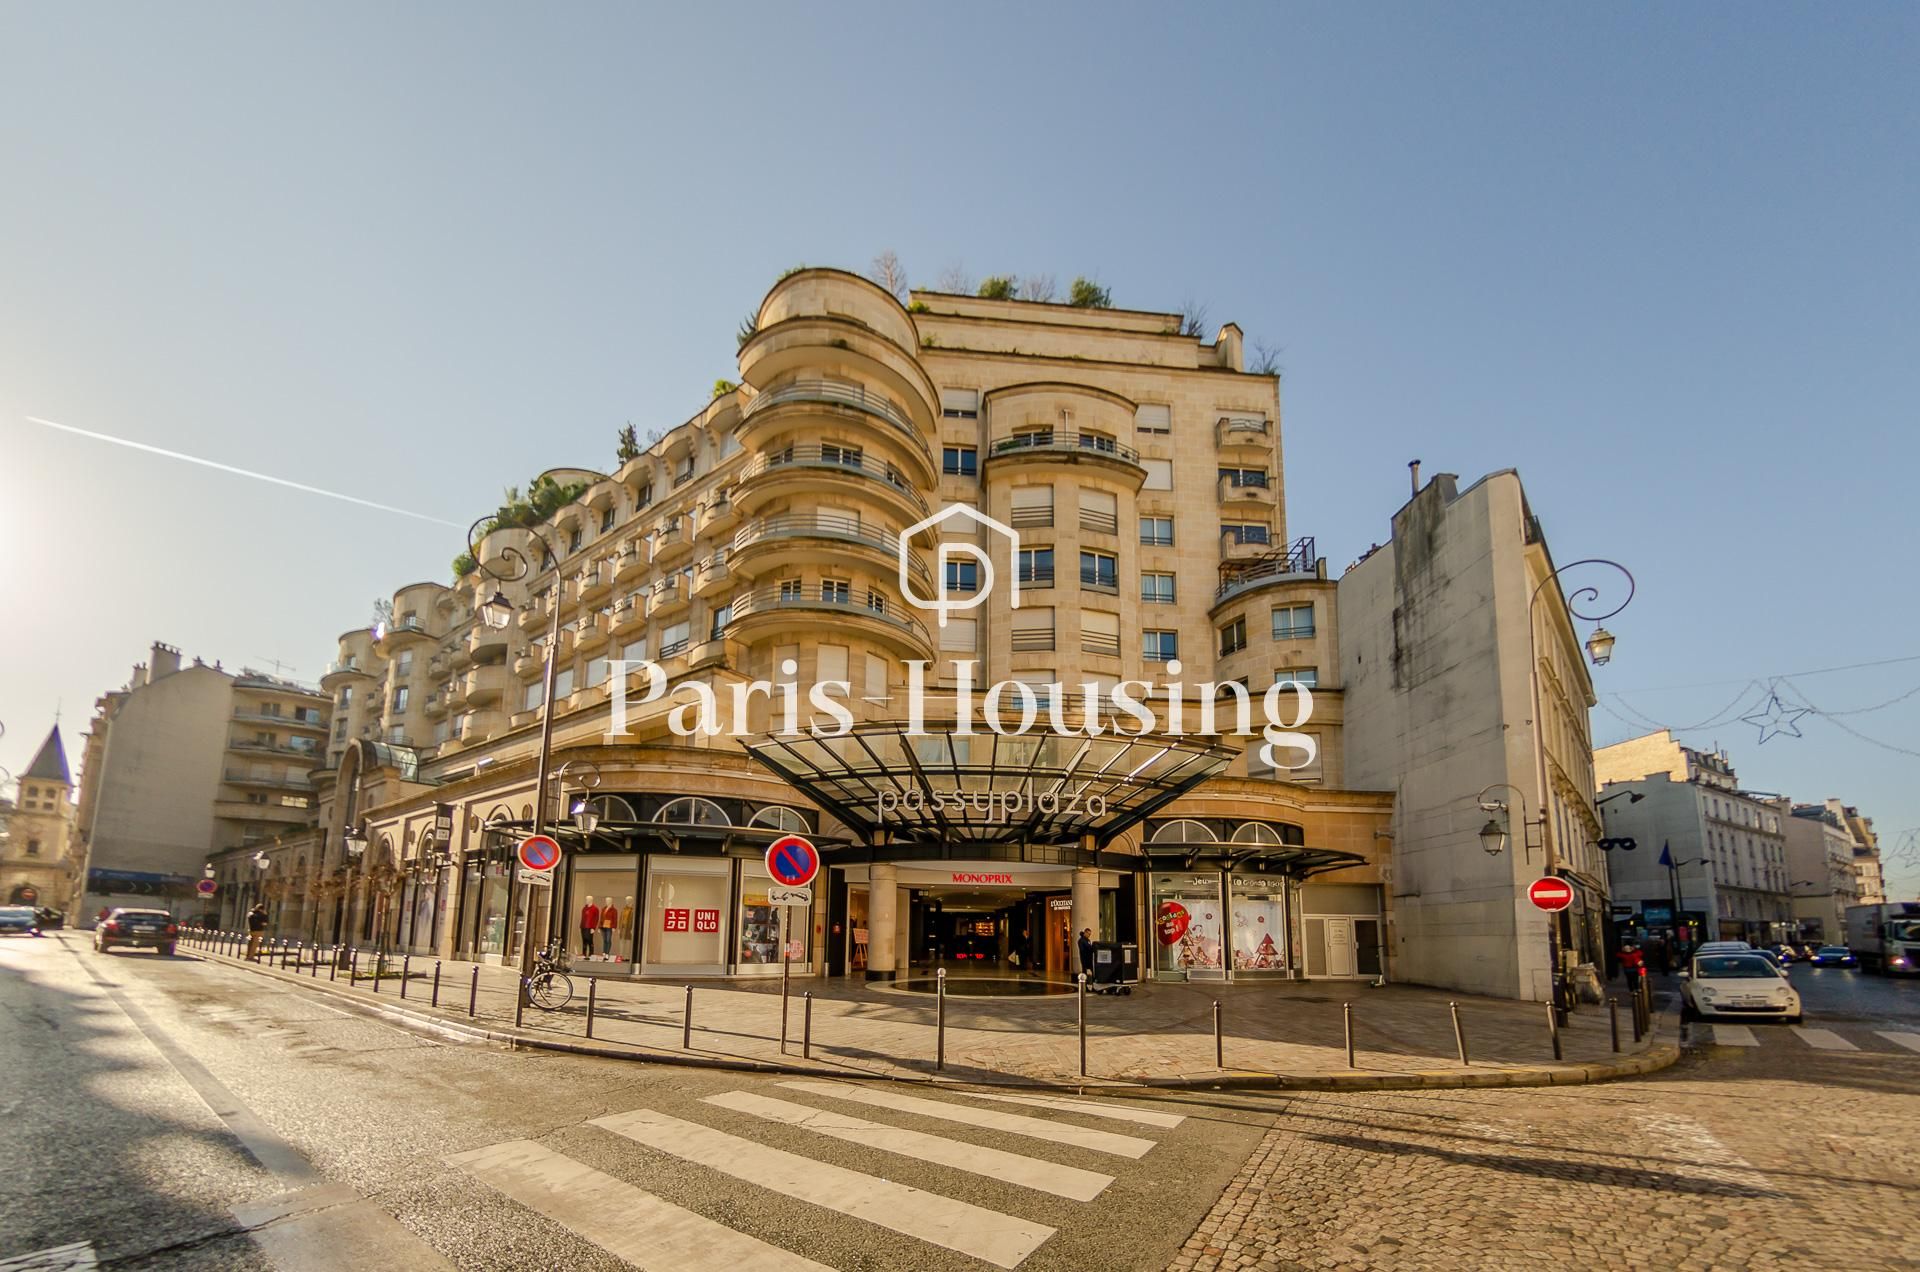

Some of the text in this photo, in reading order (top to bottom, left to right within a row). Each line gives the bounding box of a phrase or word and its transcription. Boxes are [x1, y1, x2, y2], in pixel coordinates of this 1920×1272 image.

[877, 778, 1107, 824] passyplaza
[952, 873, 1013, 884] MONOPRIX
[697, 911, 715, 920] UNI
[697, 921, 716, 930] QLO
